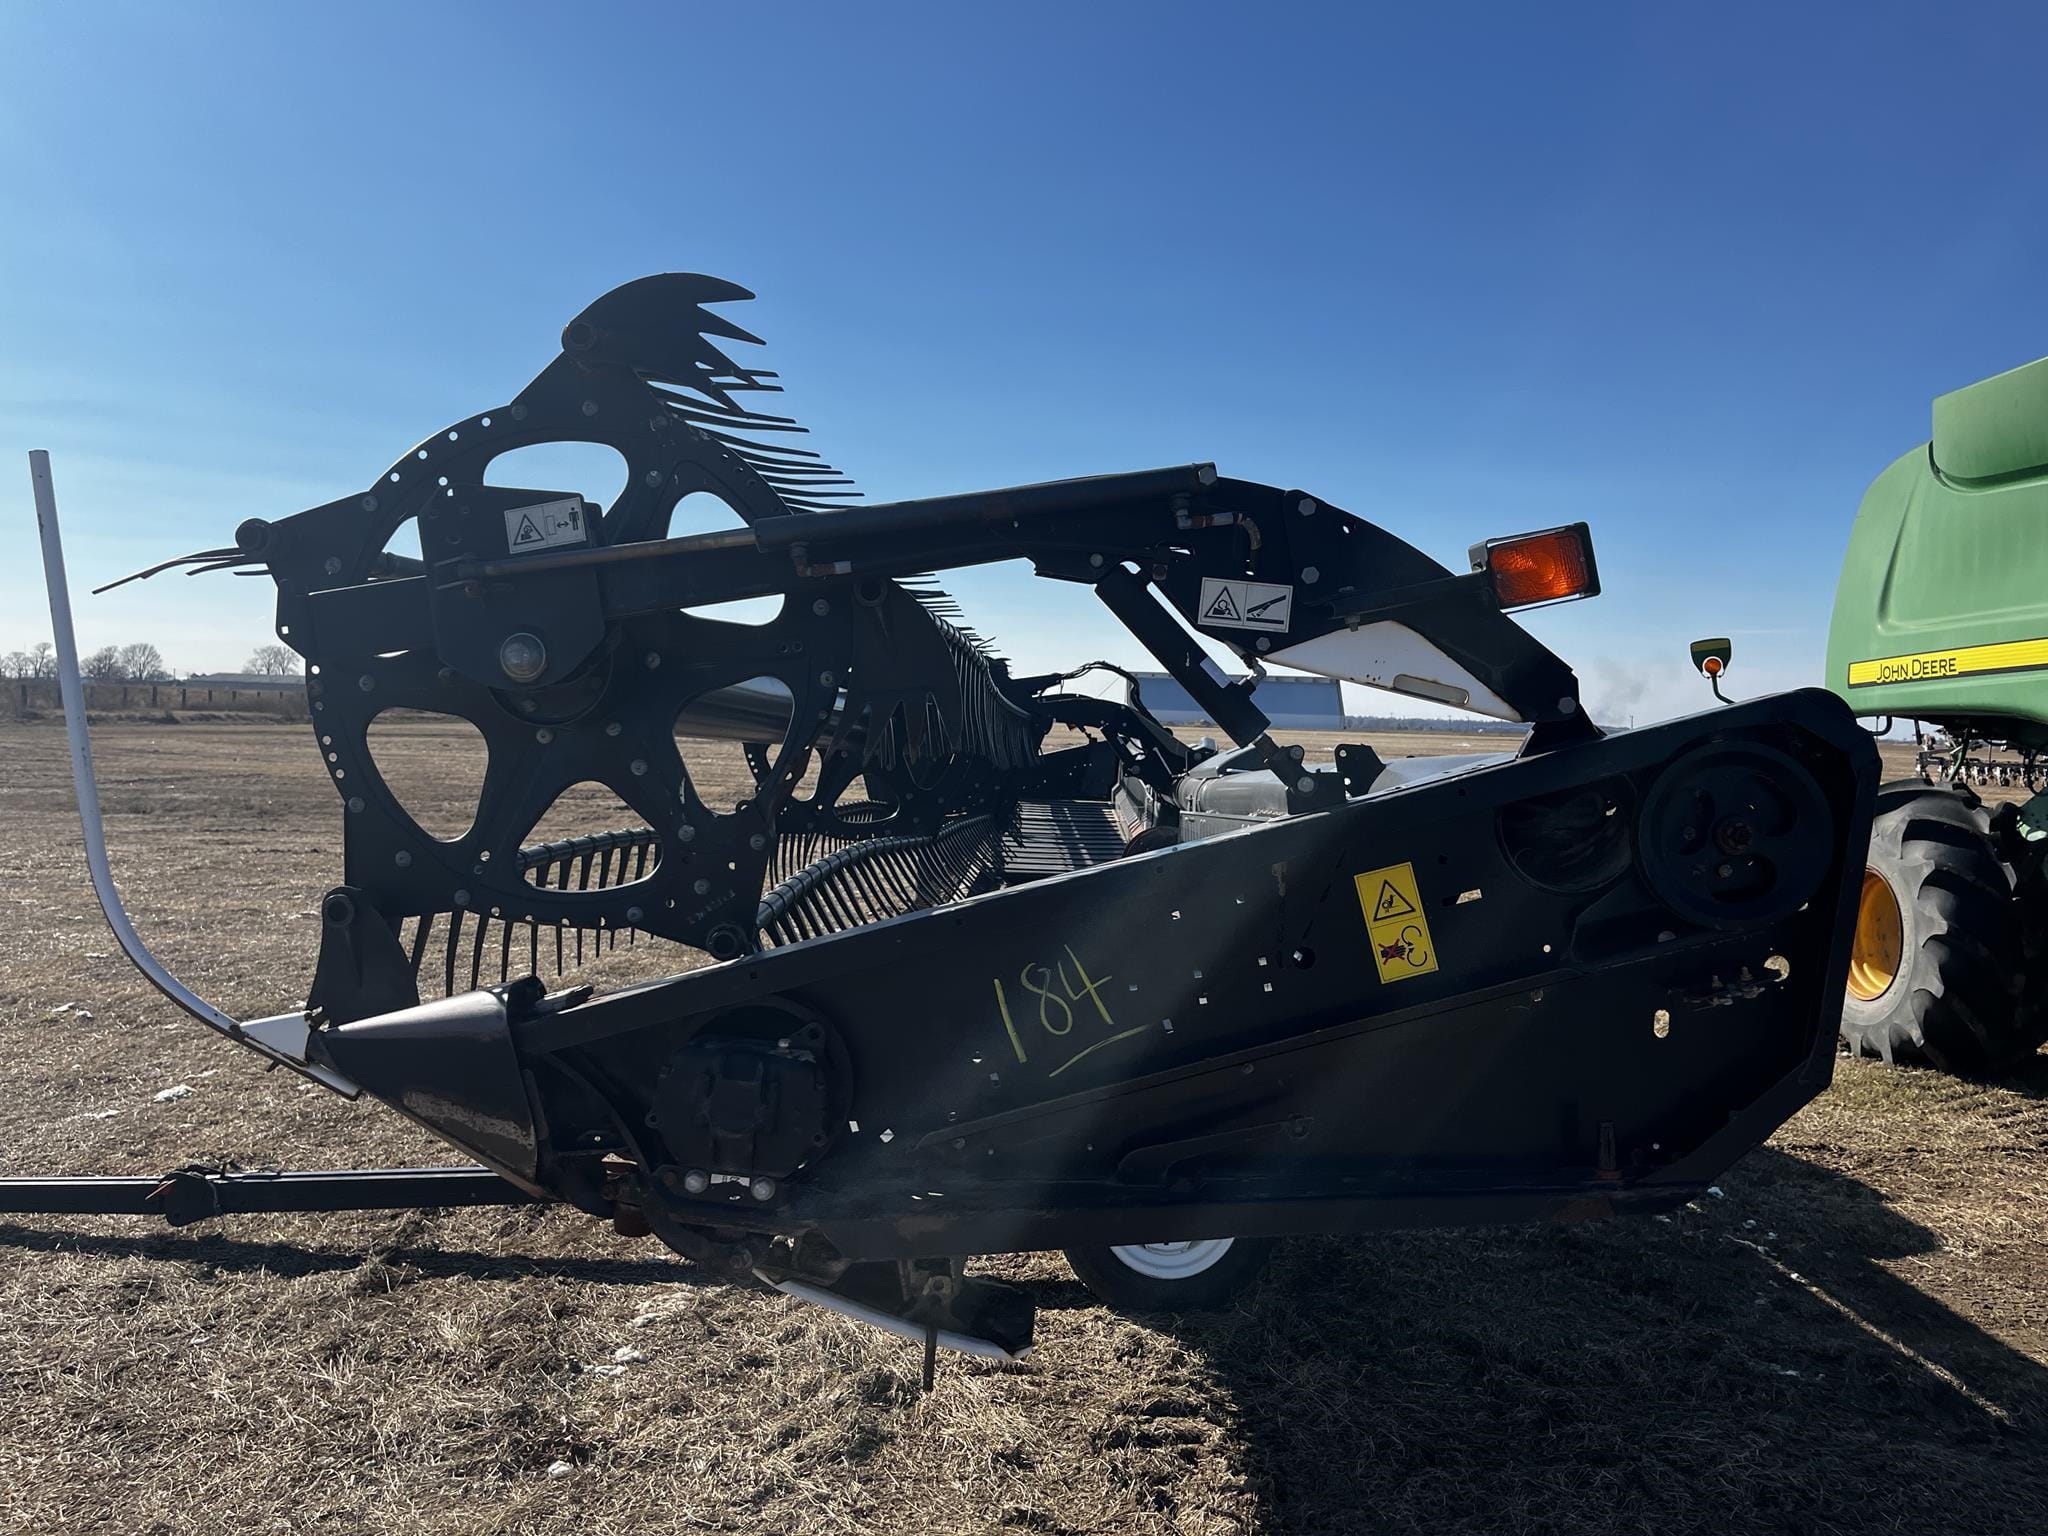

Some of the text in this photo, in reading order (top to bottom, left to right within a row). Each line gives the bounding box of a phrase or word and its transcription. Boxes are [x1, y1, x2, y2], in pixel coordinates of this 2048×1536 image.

[1876, 657, 1957, 681] JOHN DEERE
[993, 944, 1113, 1063] 184
